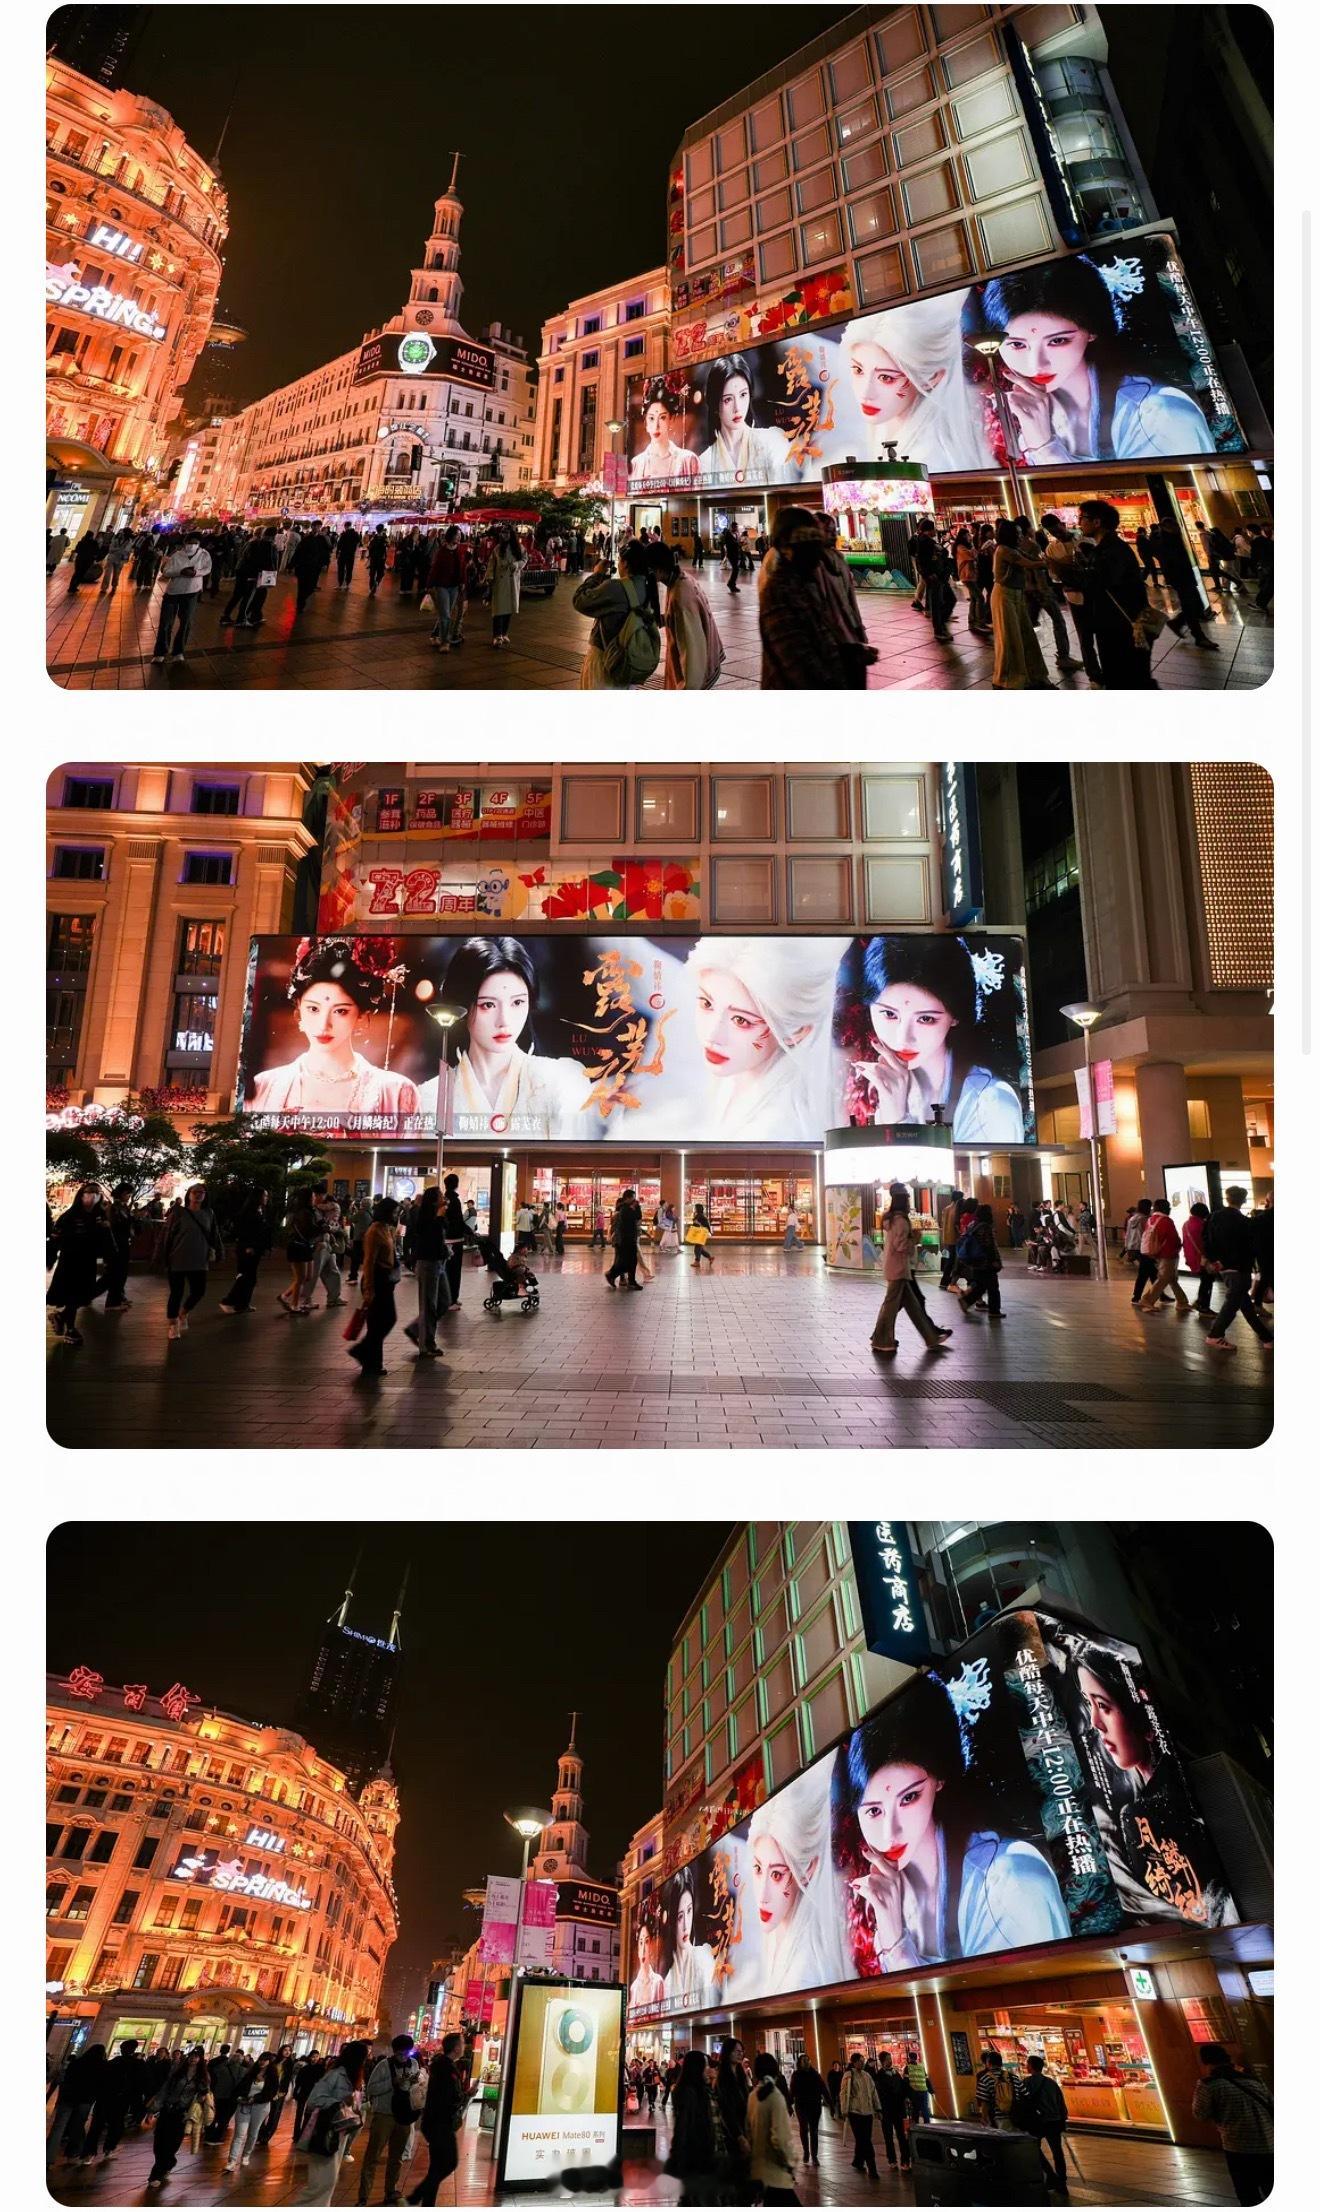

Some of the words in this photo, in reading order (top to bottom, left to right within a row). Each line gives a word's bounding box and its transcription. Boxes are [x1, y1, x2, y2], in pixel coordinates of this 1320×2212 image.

[90, 226, 144, 262] HI!
[385, 794, 399, 805] 1F
[419, 794, 436, 805] 2F
[455, 793, 471, 804] 3F
[490, 792, 508, 804] 4F
[527, 793, 543, 804] 5F
[524, 807, 545, 818] 中医
[369, 868, 441, 914] 72
[440, 895, 476, 913] 周年
[571, 1046, 601, 1056] WUY
[1015, 1648, 1097, 1875] 优酷每天中午12:00正在热播
[247, 1829, 286, 1853] HI!
[521, 2131, 560, 2140] HUAWEI
[562, 2130, 591, 2139] Mate80
